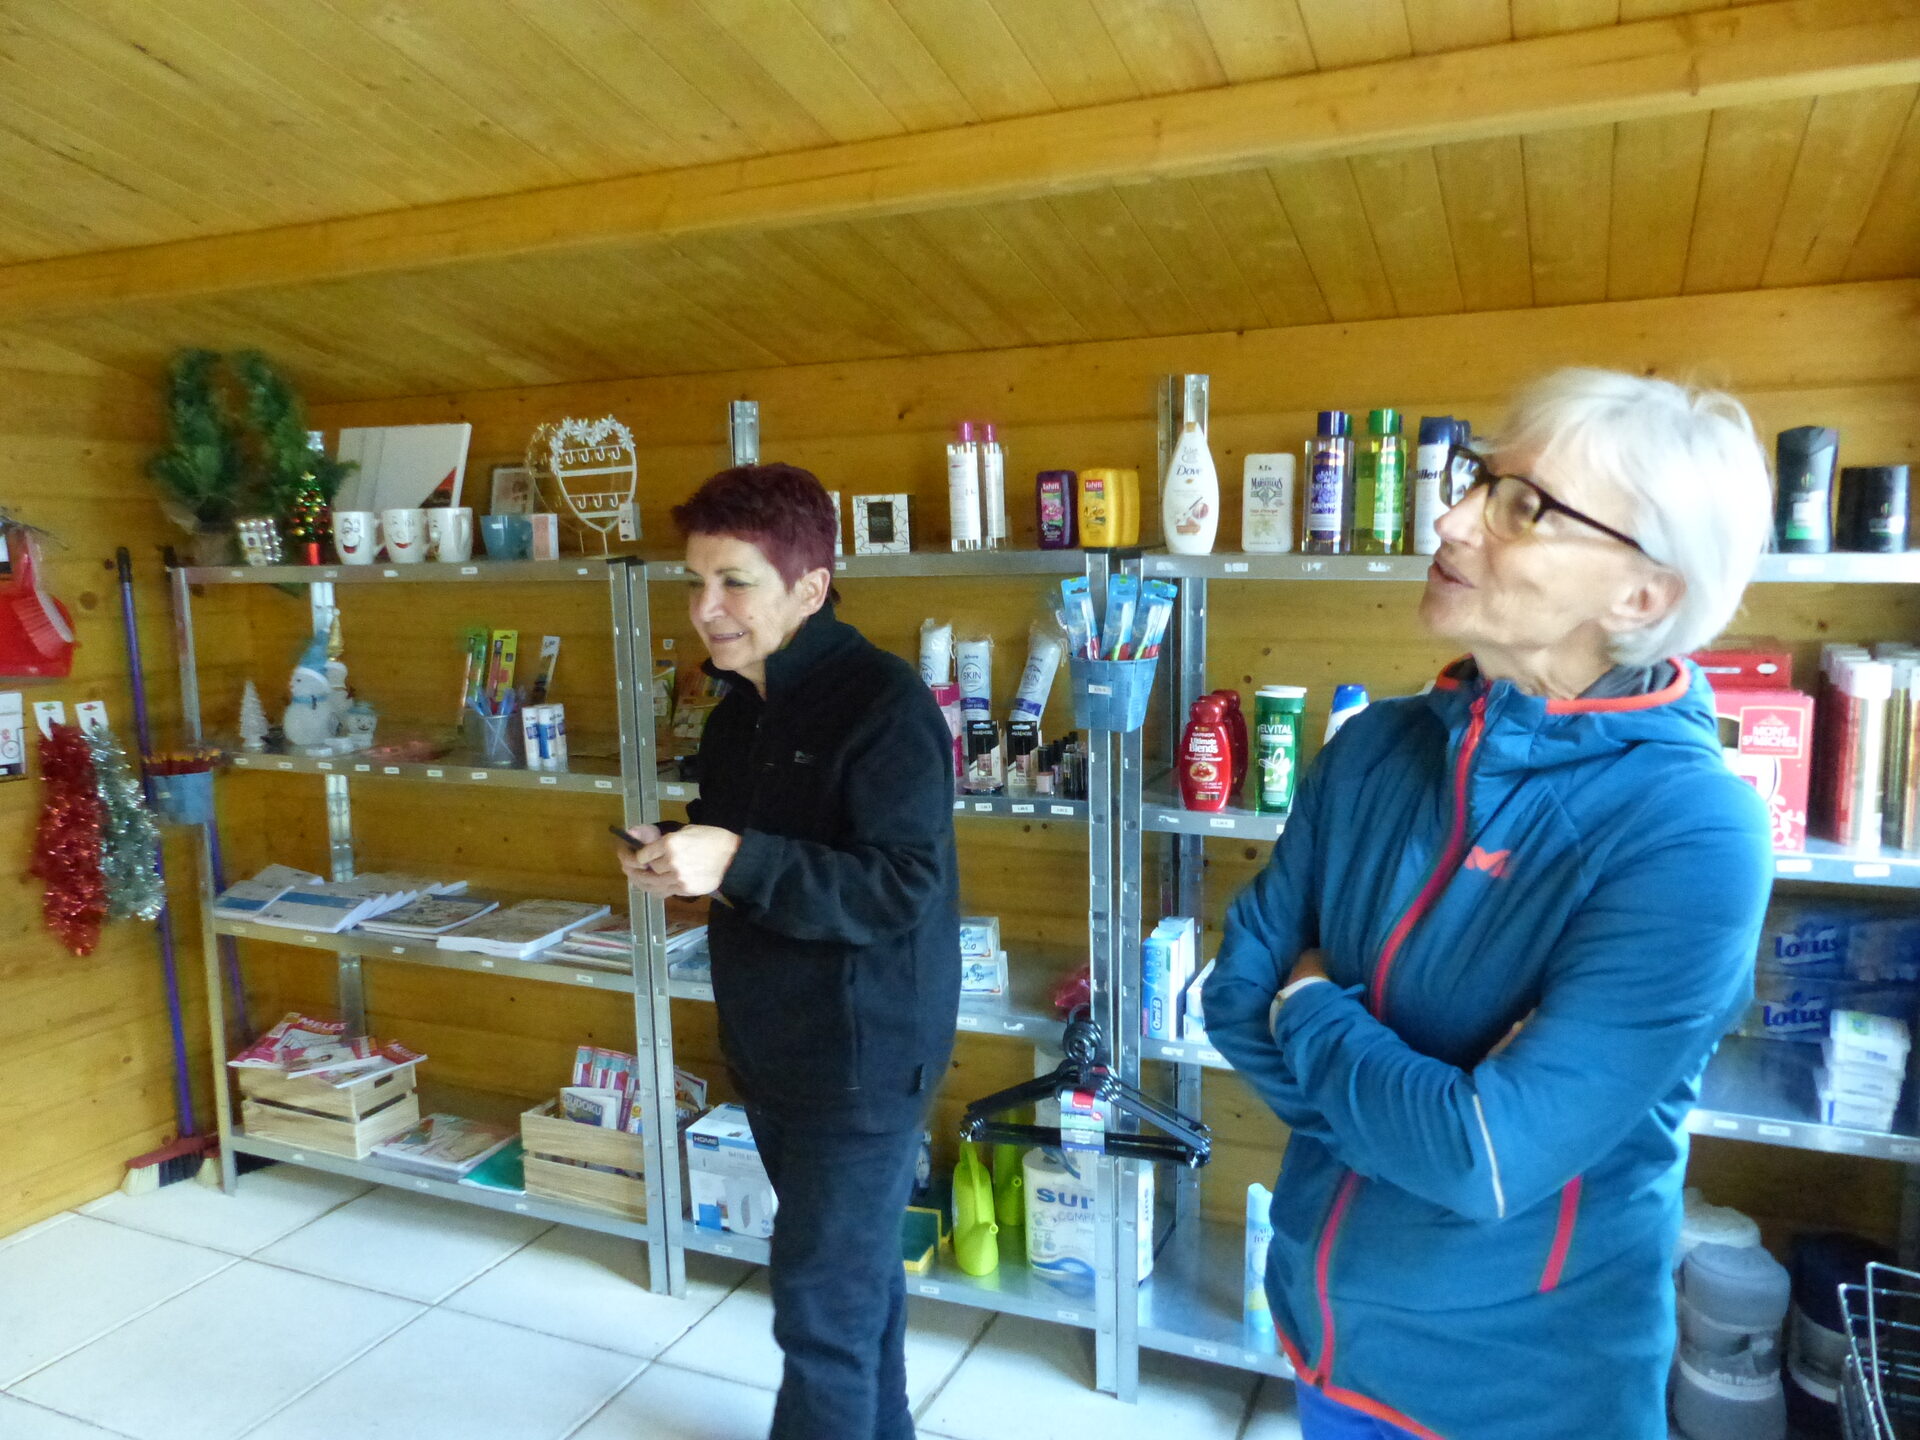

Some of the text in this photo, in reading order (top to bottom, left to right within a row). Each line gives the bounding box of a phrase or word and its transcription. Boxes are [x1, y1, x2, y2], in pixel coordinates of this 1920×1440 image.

[1176, 465, 1201, 476] Dove
[963, 671, 982, 681] SKIN
[1152, 998, 1162, 1029] Oral-B
[1763, 1004, 1828, 1027] lotus
[693, 1135, 718, 1146] HOME
